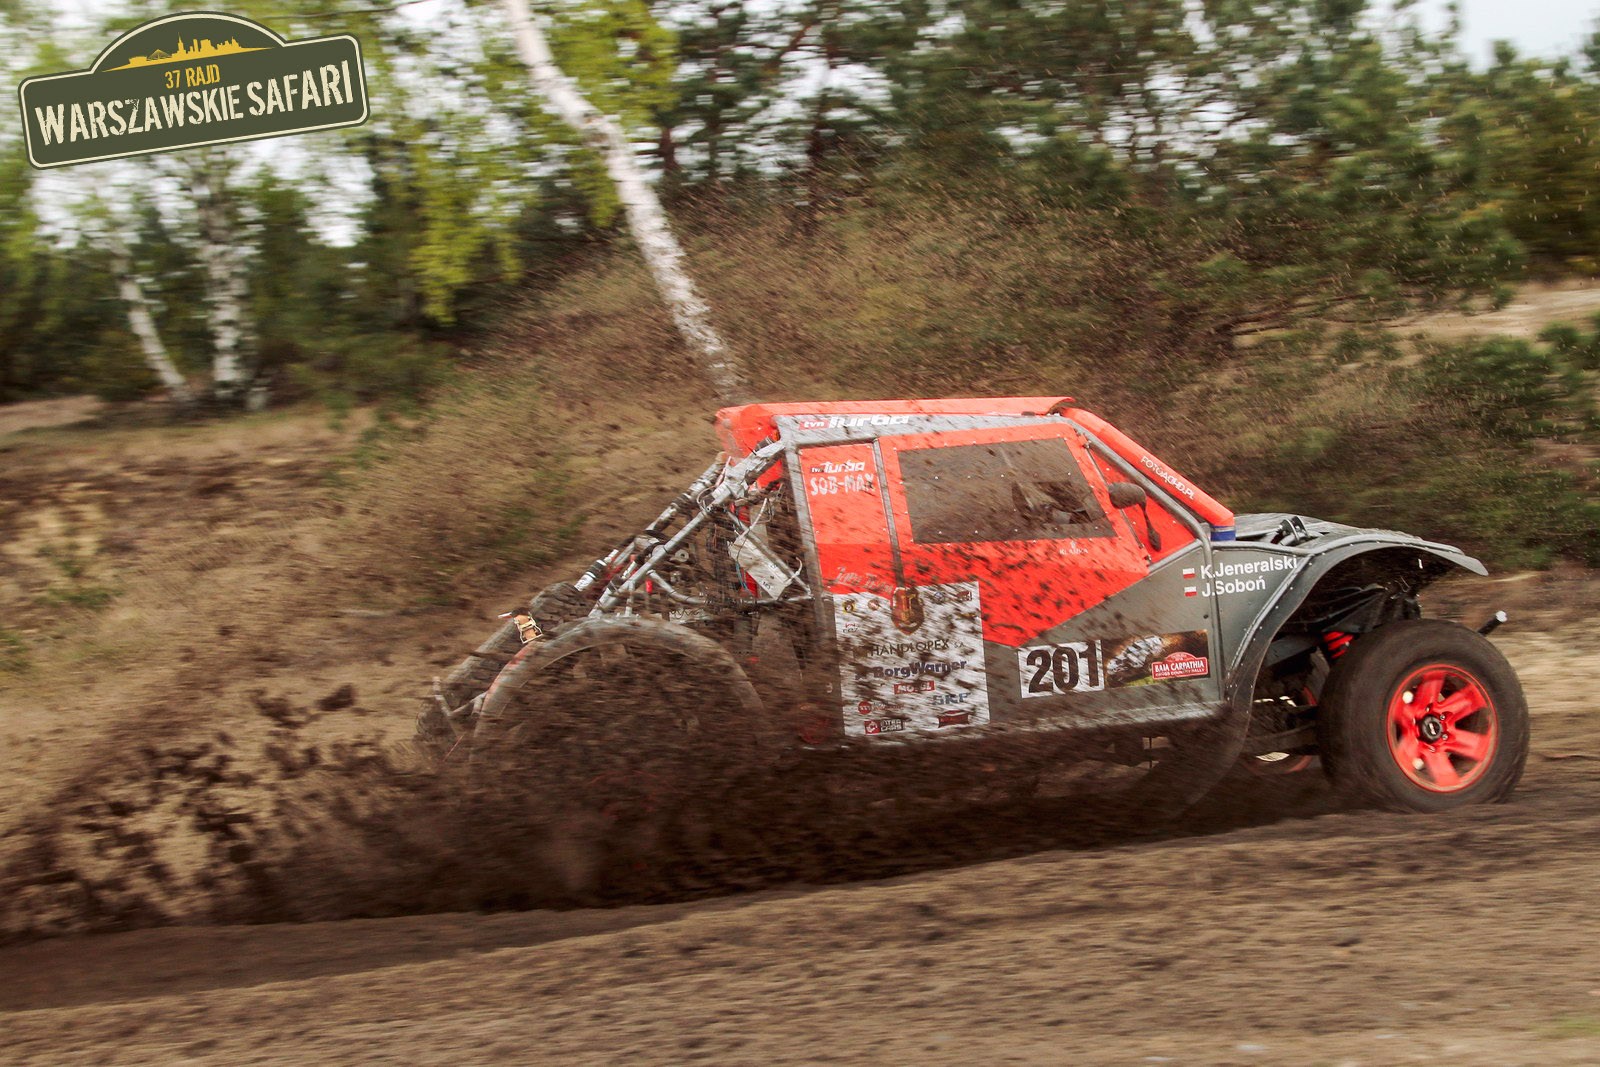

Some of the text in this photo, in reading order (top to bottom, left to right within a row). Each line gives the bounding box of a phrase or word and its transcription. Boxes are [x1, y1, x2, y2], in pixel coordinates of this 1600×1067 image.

[803, 420, 825, 428] tvn
[820, 459, 865, 473] Turbo
[1200, 555, 1298, 580] K.Jeneralski
[1201, 575, 1267, 598] J.Soboń
[870, 639, 949, 657] HANDLOPEX
[873, 660, 967, 678] BorgWarner
[1026, 641, 1100, 694] 201
[1170, 660, 1204, 671] CARPATHIA
[932, 692, 970, 705] SKF
